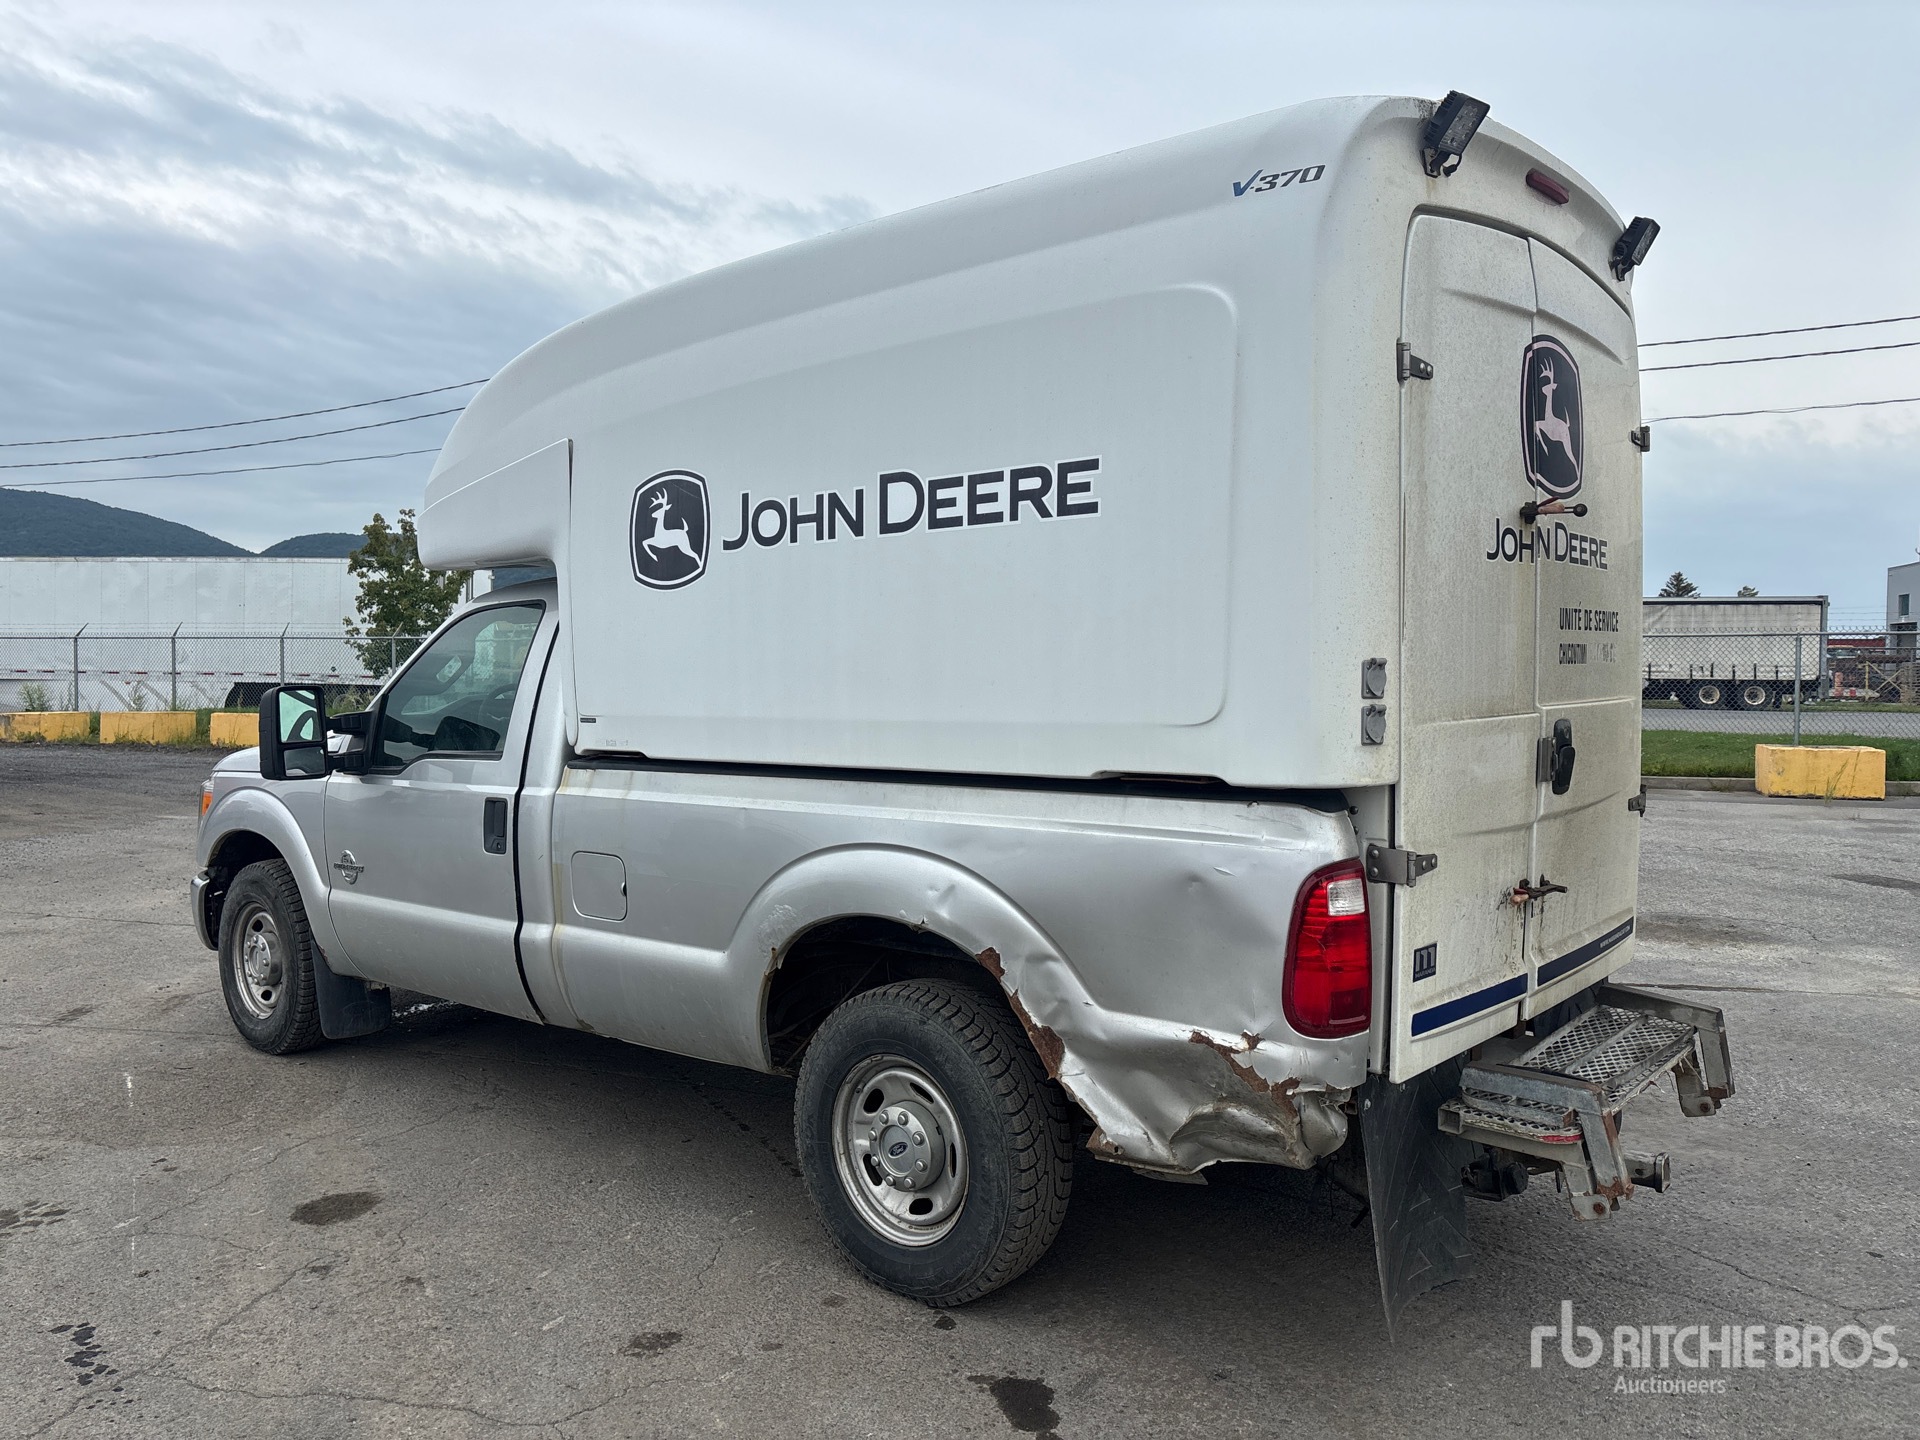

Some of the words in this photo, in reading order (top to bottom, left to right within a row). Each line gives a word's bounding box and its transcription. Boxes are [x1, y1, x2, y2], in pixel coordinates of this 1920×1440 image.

[722, 491, 865, 551] JOHN
[878, 457, 1101, 534] DEERE
[1486, 518, 1551, 564] JOHN
[1554, 521, 1608, 570] DEERE
[1583, 609, 1593, 632] DE
[1594, 609, 1619, 633] SERVICE
